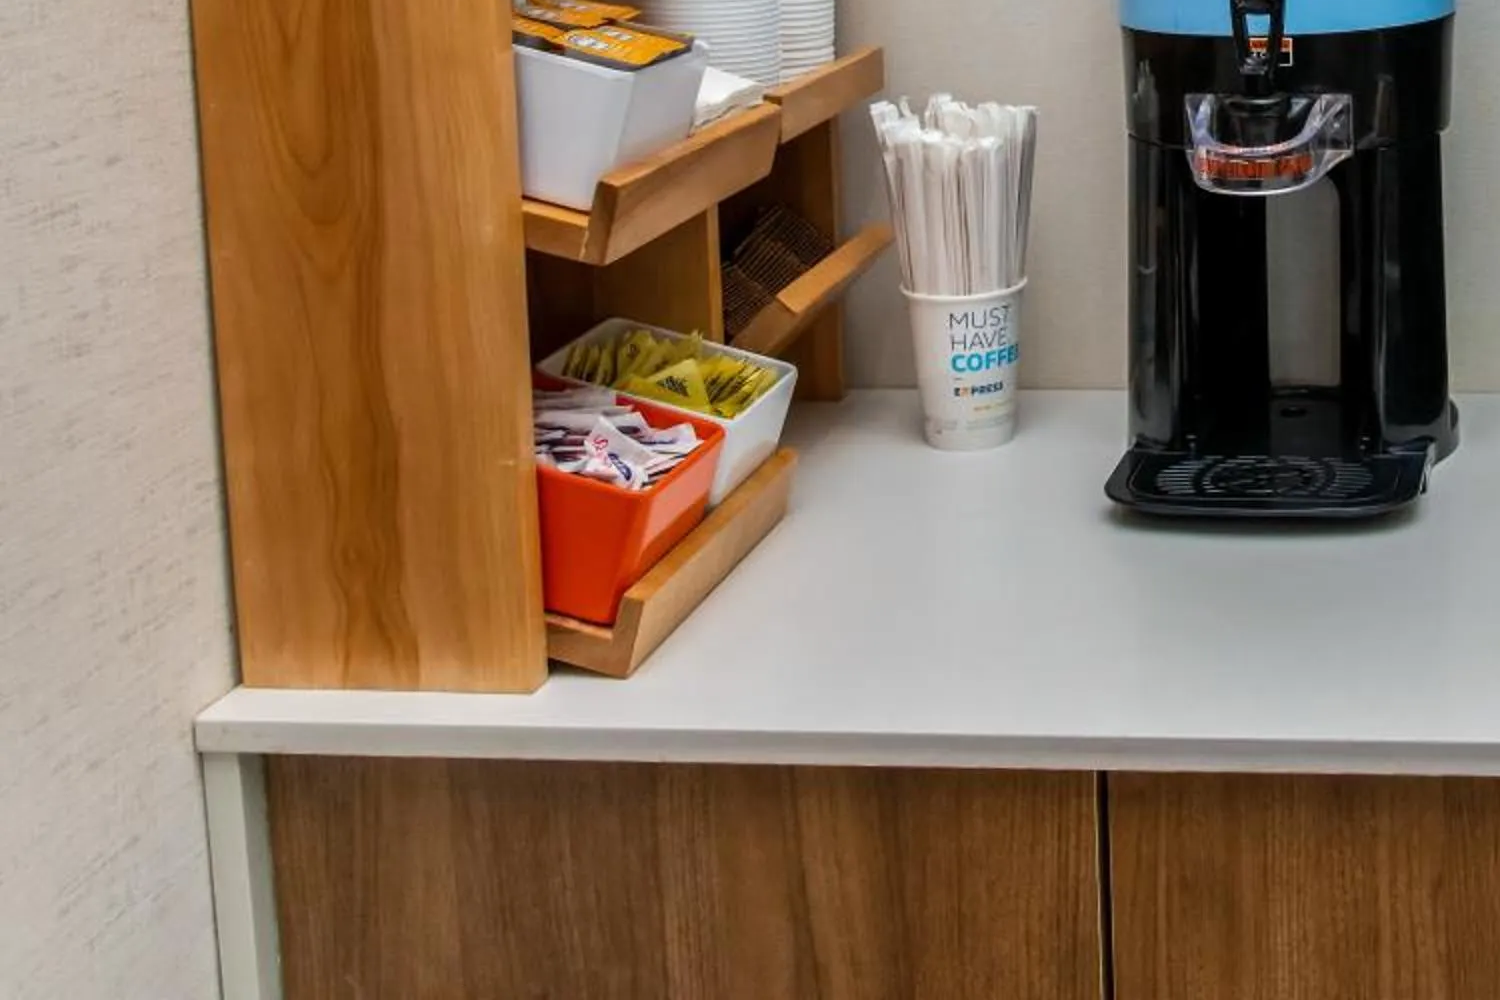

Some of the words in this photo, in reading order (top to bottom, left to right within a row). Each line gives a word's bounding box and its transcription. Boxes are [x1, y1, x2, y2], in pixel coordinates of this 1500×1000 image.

[948, 305, 1010, 329] MUST
[951, 327, 1008, 351] HAVE
[950, 342, 1020, 373] COFFE
